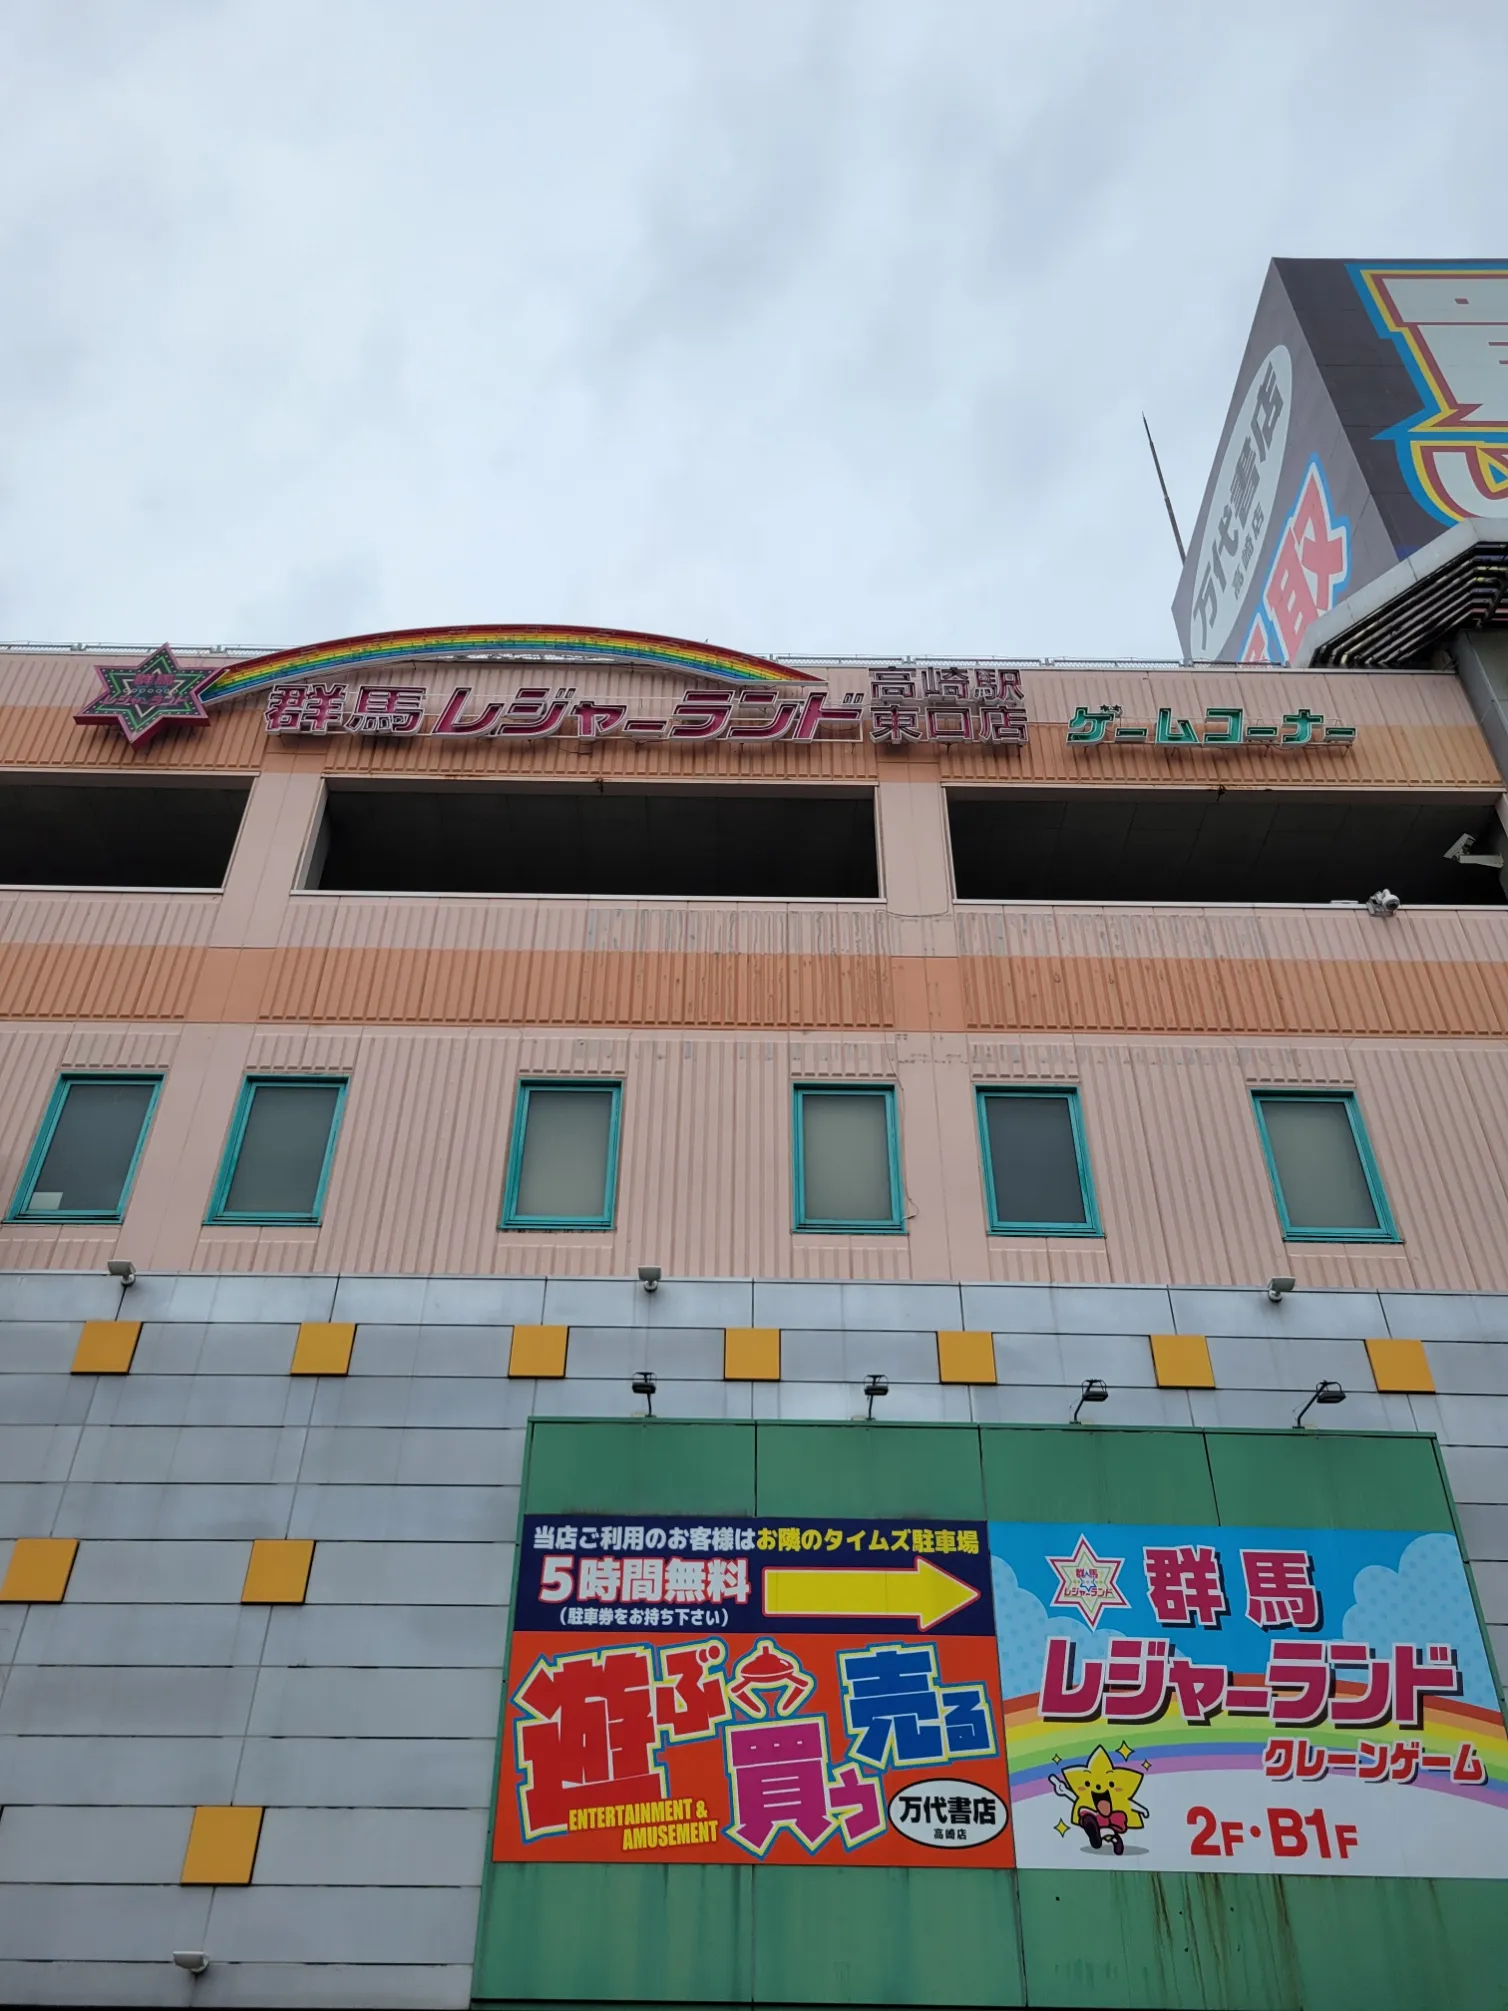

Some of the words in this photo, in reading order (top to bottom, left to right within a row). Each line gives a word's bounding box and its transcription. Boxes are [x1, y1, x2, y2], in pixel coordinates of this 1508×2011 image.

[1192, 360, 1285, 652] 万代書店
[869, 667, 1022, 701] 高崎駅
[264, 682, 865, 741] 群馬レジャーランド
[870, 703, 1027, 744] 東口店
[1066, 703, 1356, 748] ゲームコーナー
[533, 1525, 980, 1555] 当店ご利用のお客様はお隣のタイムズ駐車場
[539, 1555, 751, 1604] 5時間無料
[1143, 1545, 1320, 1629] 群馬
[1038, 1636, 1460, 1727] レジャーランド
[842, 1646, 995, 1767] 売る
[518, 1641, 731, 1835] 遊ぶ
[1263, 1737, 1486, 1785] クレーンゲーム
[726, 1718, 886, 1853] 買う
[568, 1799, 692, 1832] ENTERTAINMENT
[695, 1798, 709, 1819] &
[898, 1796, 998, 1826] 万代書店
[933, 1827, 968, 1841] 高崎店
[622, 1820, 719, 1851] AMUSEMENT
